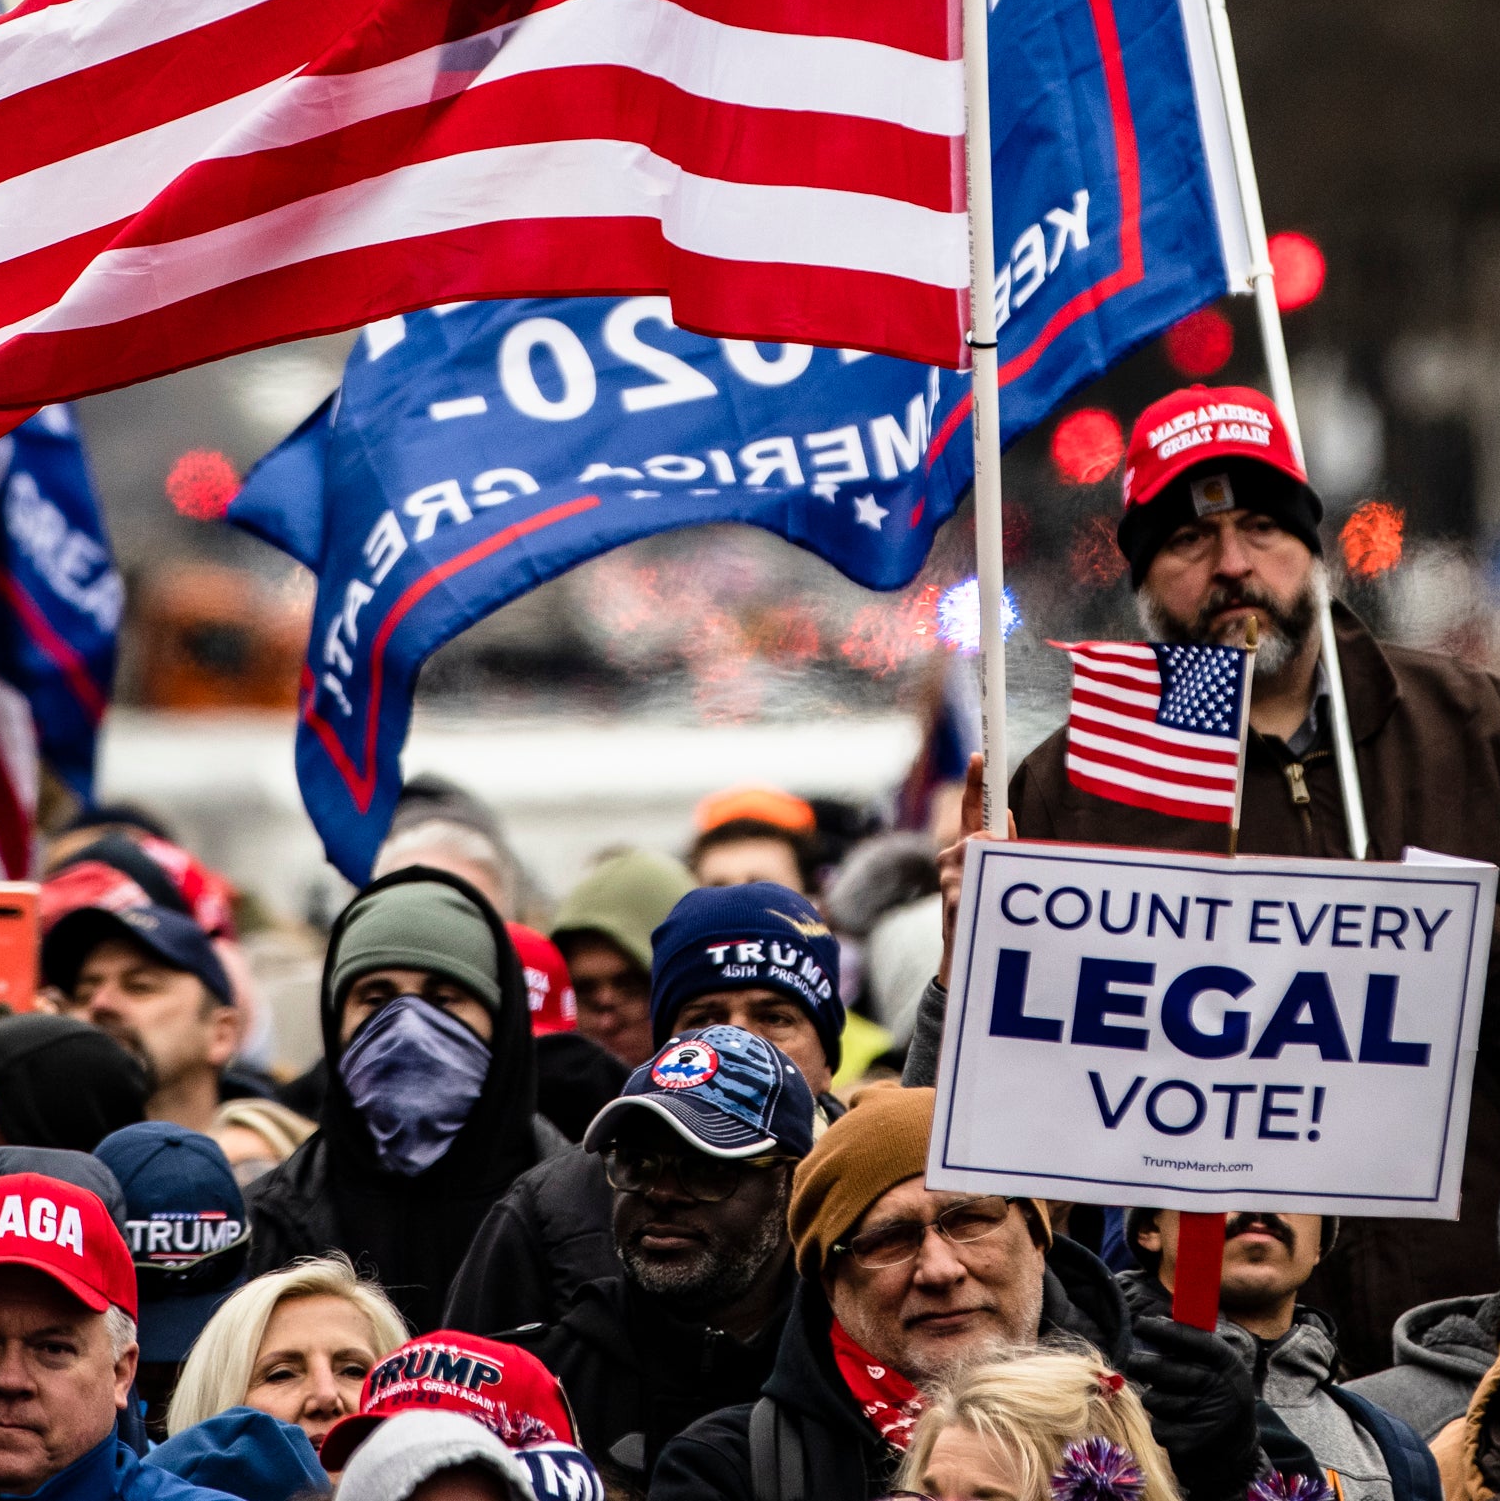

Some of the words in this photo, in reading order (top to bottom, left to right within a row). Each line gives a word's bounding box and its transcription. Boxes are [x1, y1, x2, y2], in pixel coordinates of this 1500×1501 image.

[1147, 411, 1197, 449] MAKE
[1197, 403, 1274, 430] AMERICA
[1157, 425, 1213, 460] GREAT
[1217, 423, 1271, 446] AGAIN
[999, 882, 1233, 942] COUNT
[1247, 899, 1454, 953] EVERY
[706, 942, 833, 1000] TRUMP
[721, 964, 758, 978] 45TH
[988, 947, 1433, 1068] LEGAL
[1087, 1069, 1327, 1143] VOTE!
[1142, 1155, 1254, 1174] TrumpMarch.com
[124, 1219, 242, 1253] TRUMP
[369, 1349, 504, 1396] TRUMP
[391, 1390, 441, 1406] 2020
[421, 1380, 460, 1397] GREAT
[459, 1388, 496, 1413] AGAIN
